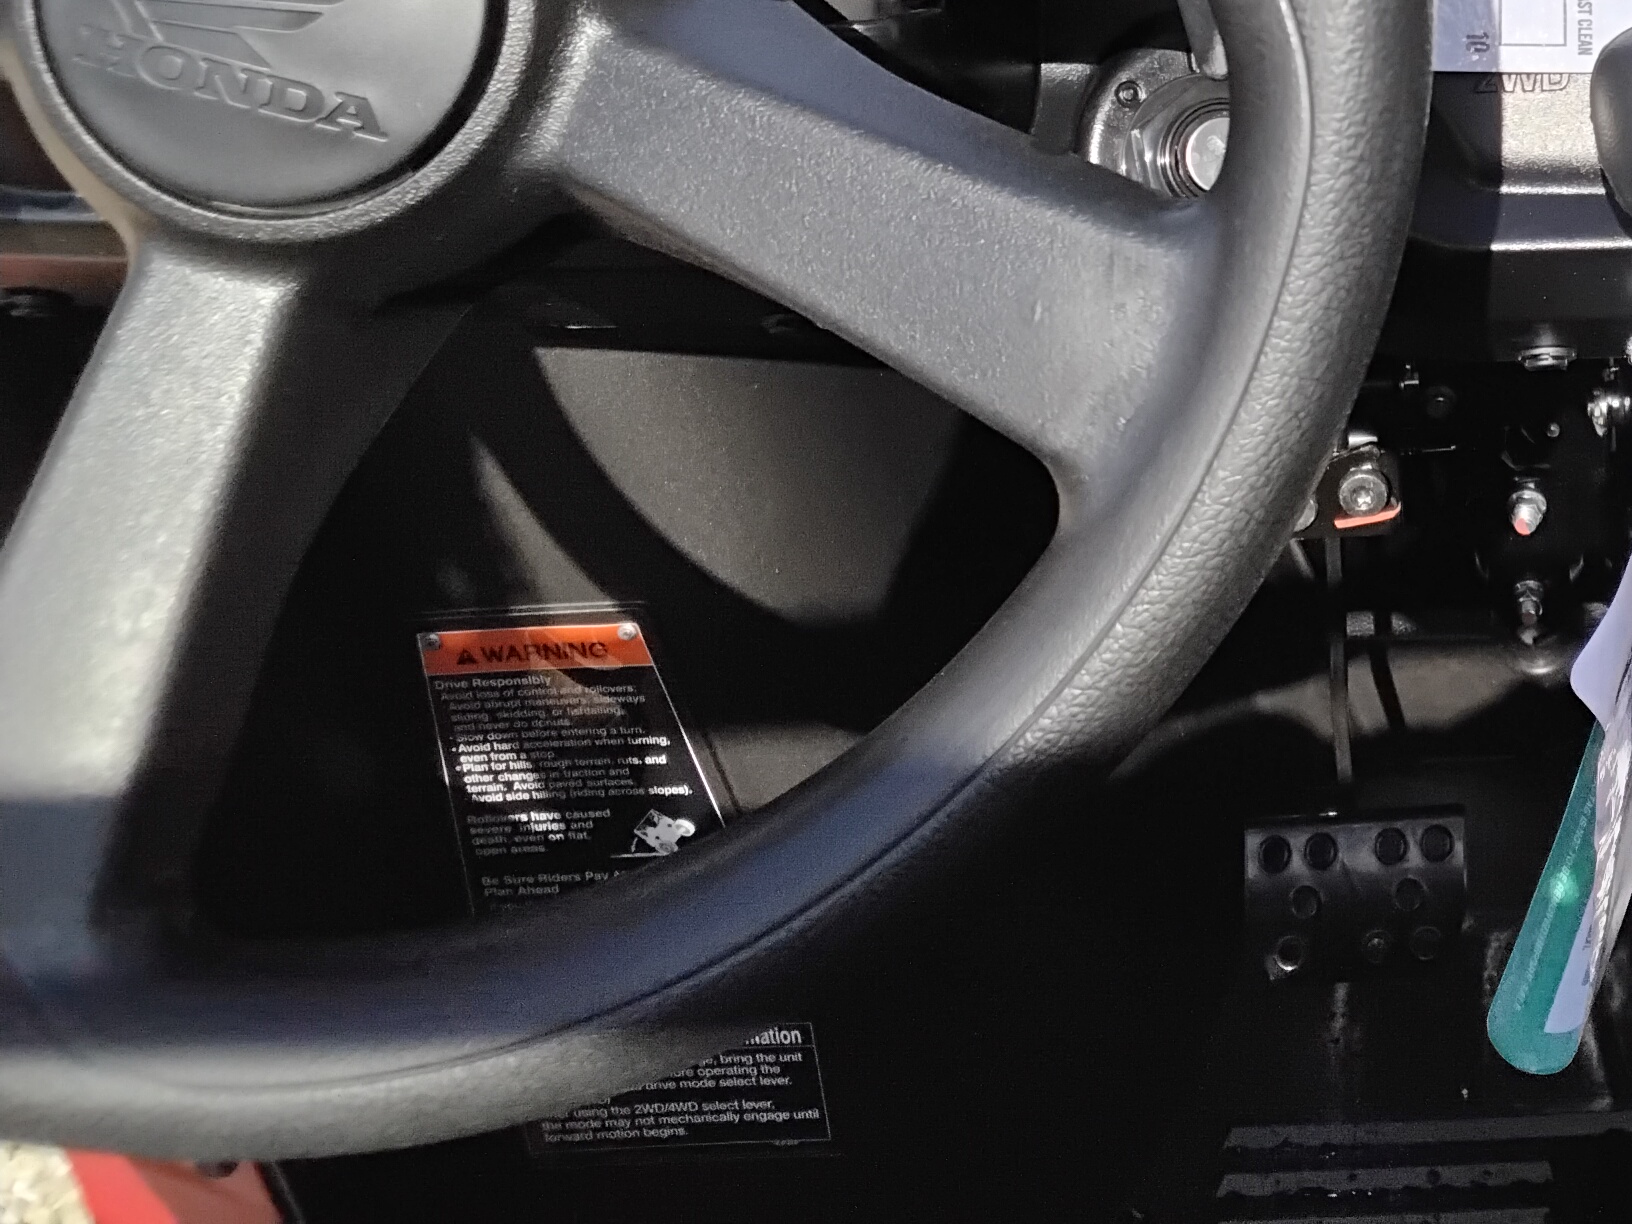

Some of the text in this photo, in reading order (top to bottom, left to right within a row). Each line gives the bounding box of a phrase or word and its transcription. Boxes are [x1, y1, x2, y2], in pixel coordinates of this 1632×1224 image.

[1466, 32, 1490, 53] 10
[1577, 19, 1592, 56] CLEAN
[72, 23, 388, 142] HONDA
[481, 642, 608, 663] WARNING
[458, 736, 670, 752] Avoid hard turning,
[461, 752, 517, 762] even from
[463, 755, 666, 772] Plan for and
[464, 772, 546, 783] other changes
[466, 782, 545, 793] terrain. Avoid
[472, 785, 695, 802] Avoid side slopes).
[530, 811, 561, 821] have
[520, 822, 566, 833] injuries
[720, 1054, 752, 1065] bring
[756, 1053, 776, 1063] the
[779, 1052, 803, 1062] unit
[698, 1065, 757, 1077] operating
[761, 1064, 780, 1074] the
[680, 1076, 792, 1088] mode select lever.
[611, 1099, 775, 1115] the 2WD/4WD select lever.
[605, 1108, 820, 1128] may not engage until
